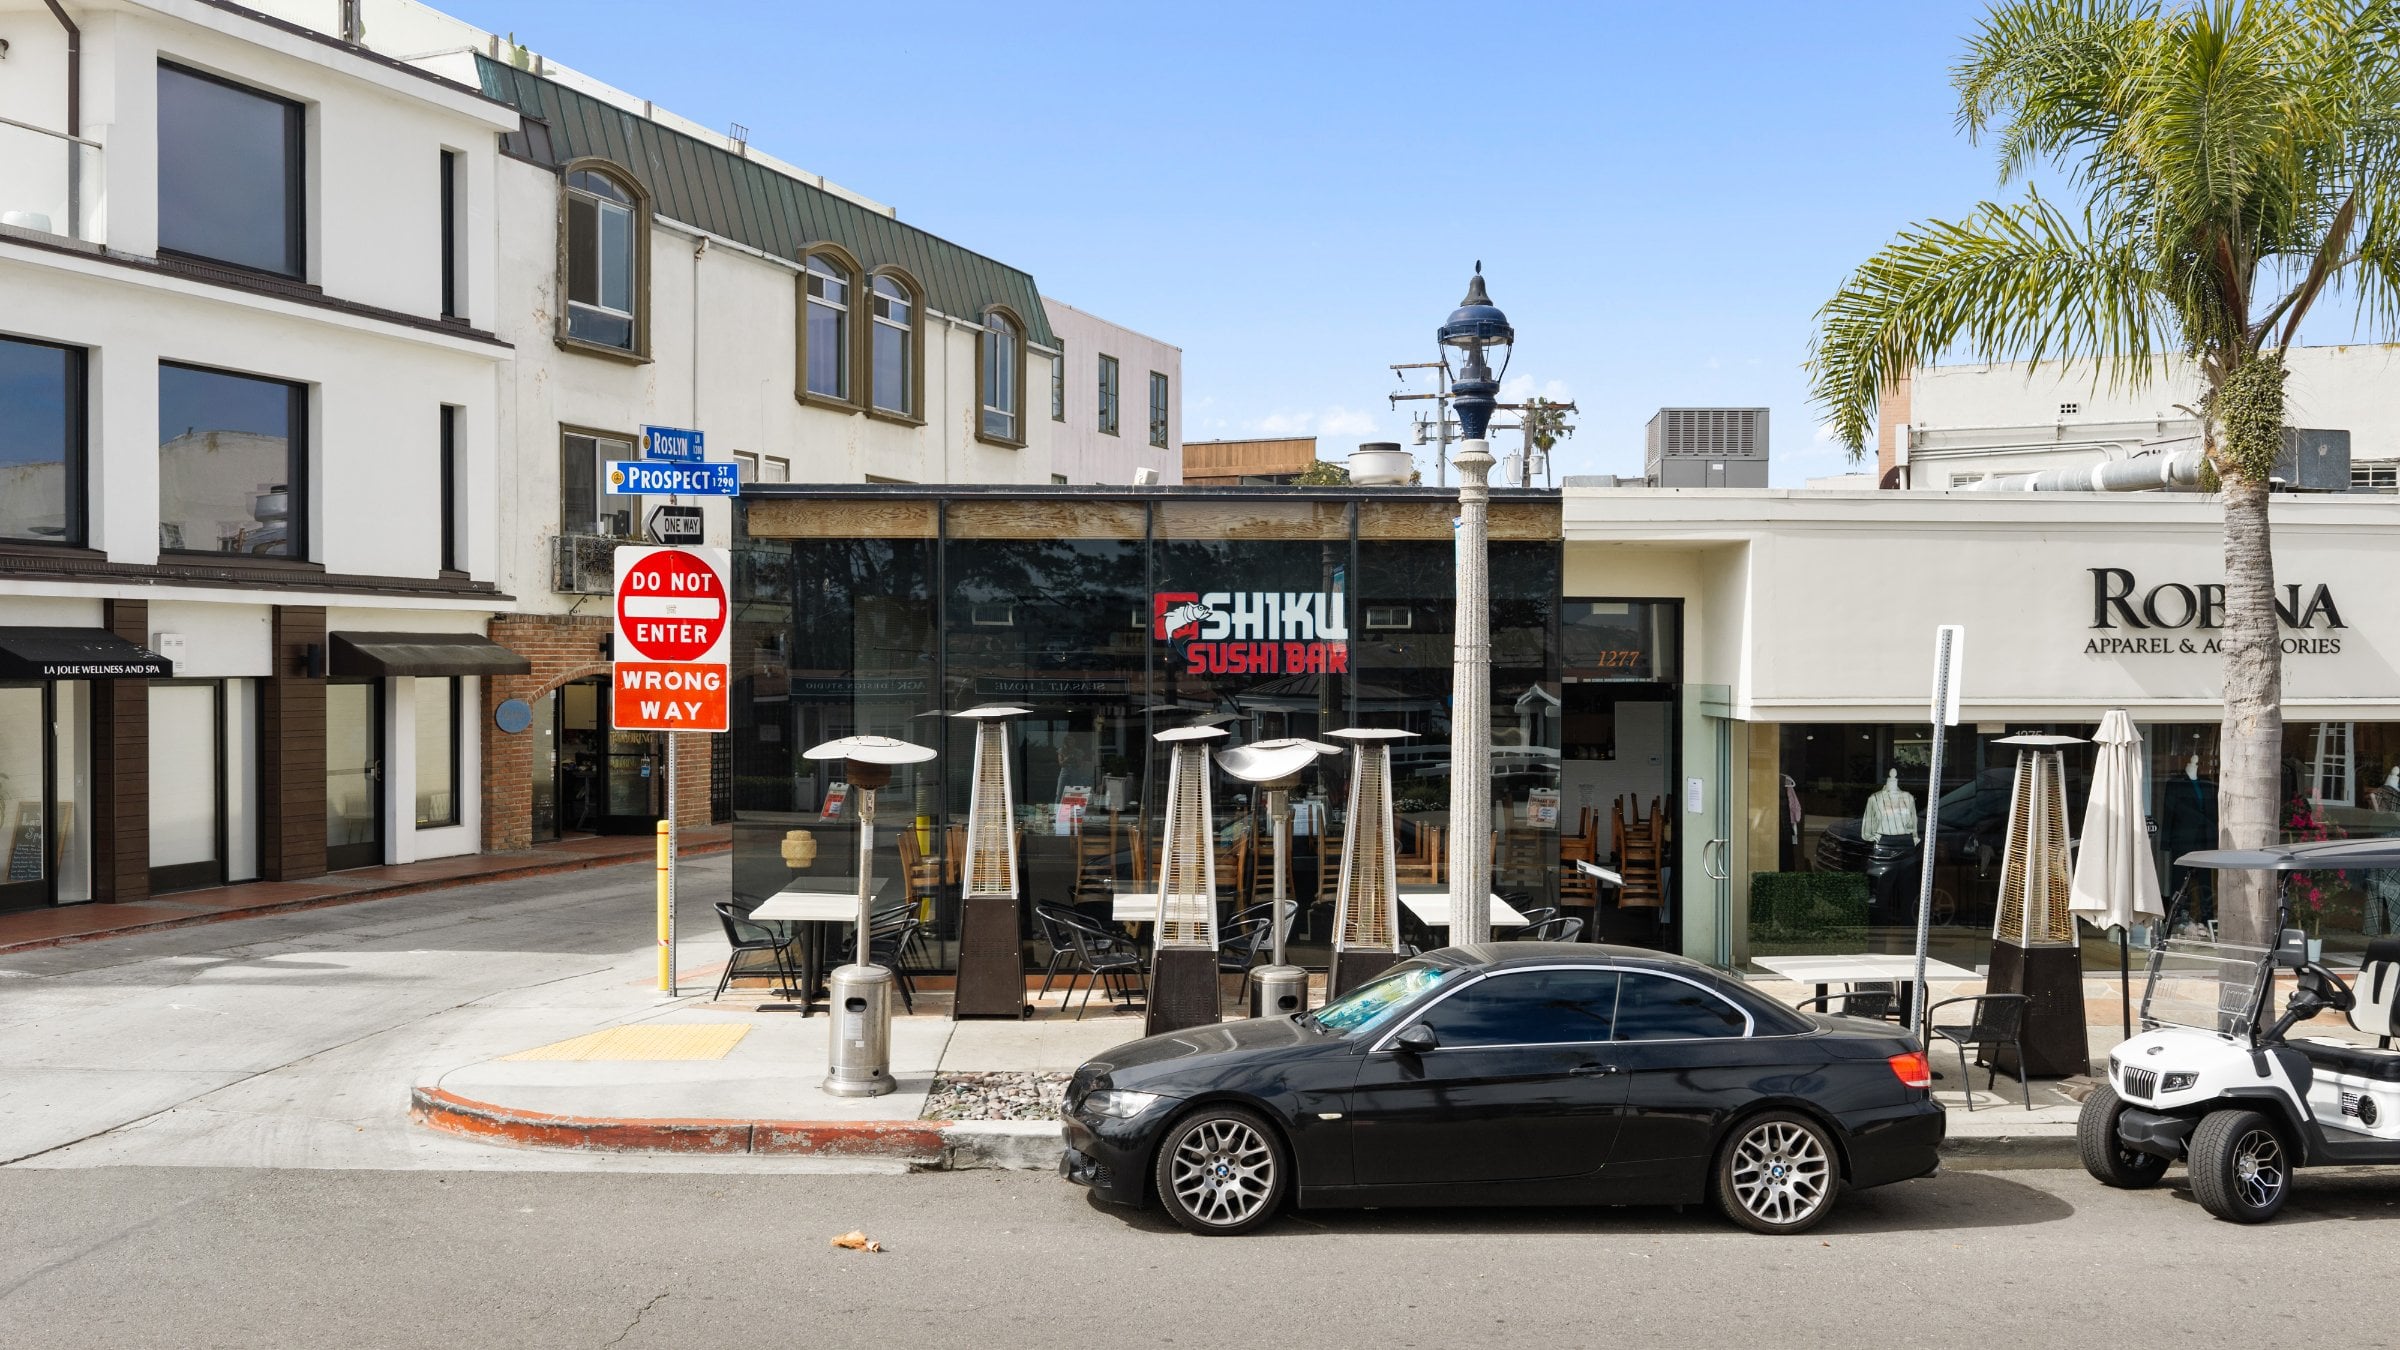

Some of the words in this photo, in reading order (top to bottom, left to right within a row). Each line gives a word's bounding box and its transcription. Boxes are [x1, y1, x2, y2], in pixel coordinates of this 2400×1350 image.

[654, 431, 688, 456] ROSLYN
[628, 466, 711, 490] PROSPECT
[718, 466, 729, 476] ST
[712, 477, 734, 487] 1290
[664, 518, 681, 533] ONE
[683, 518, 699, 533] WAY
[632, 571, 661, 591] DO
[671, 572, 713, 592] NOT
[2086, 567, 2349, 629] ROBNA
[636, 623, 707, 644] ENTER
[2083, 637, 2175, 654] APPAREL
[2179, 637, 2198, 655] &
[2203, 637, 2341, 654] AORIES
[1186, 642, 1279, 674] SUSHI
[1283, 642, 1348, 674] BAR
[1598, 650, 1640, 667] 1277
[44, 665, 55, 674] LA
[57, 665, 80, 676] JOLIE
[81, 665, 123, 674] WELLNESS
[124, 665, 144, 674] AND
[145, 665, 160, 674] SPA
[622, 670, 720, 691] WRONG
[640, 701, 703, 721] WAY
